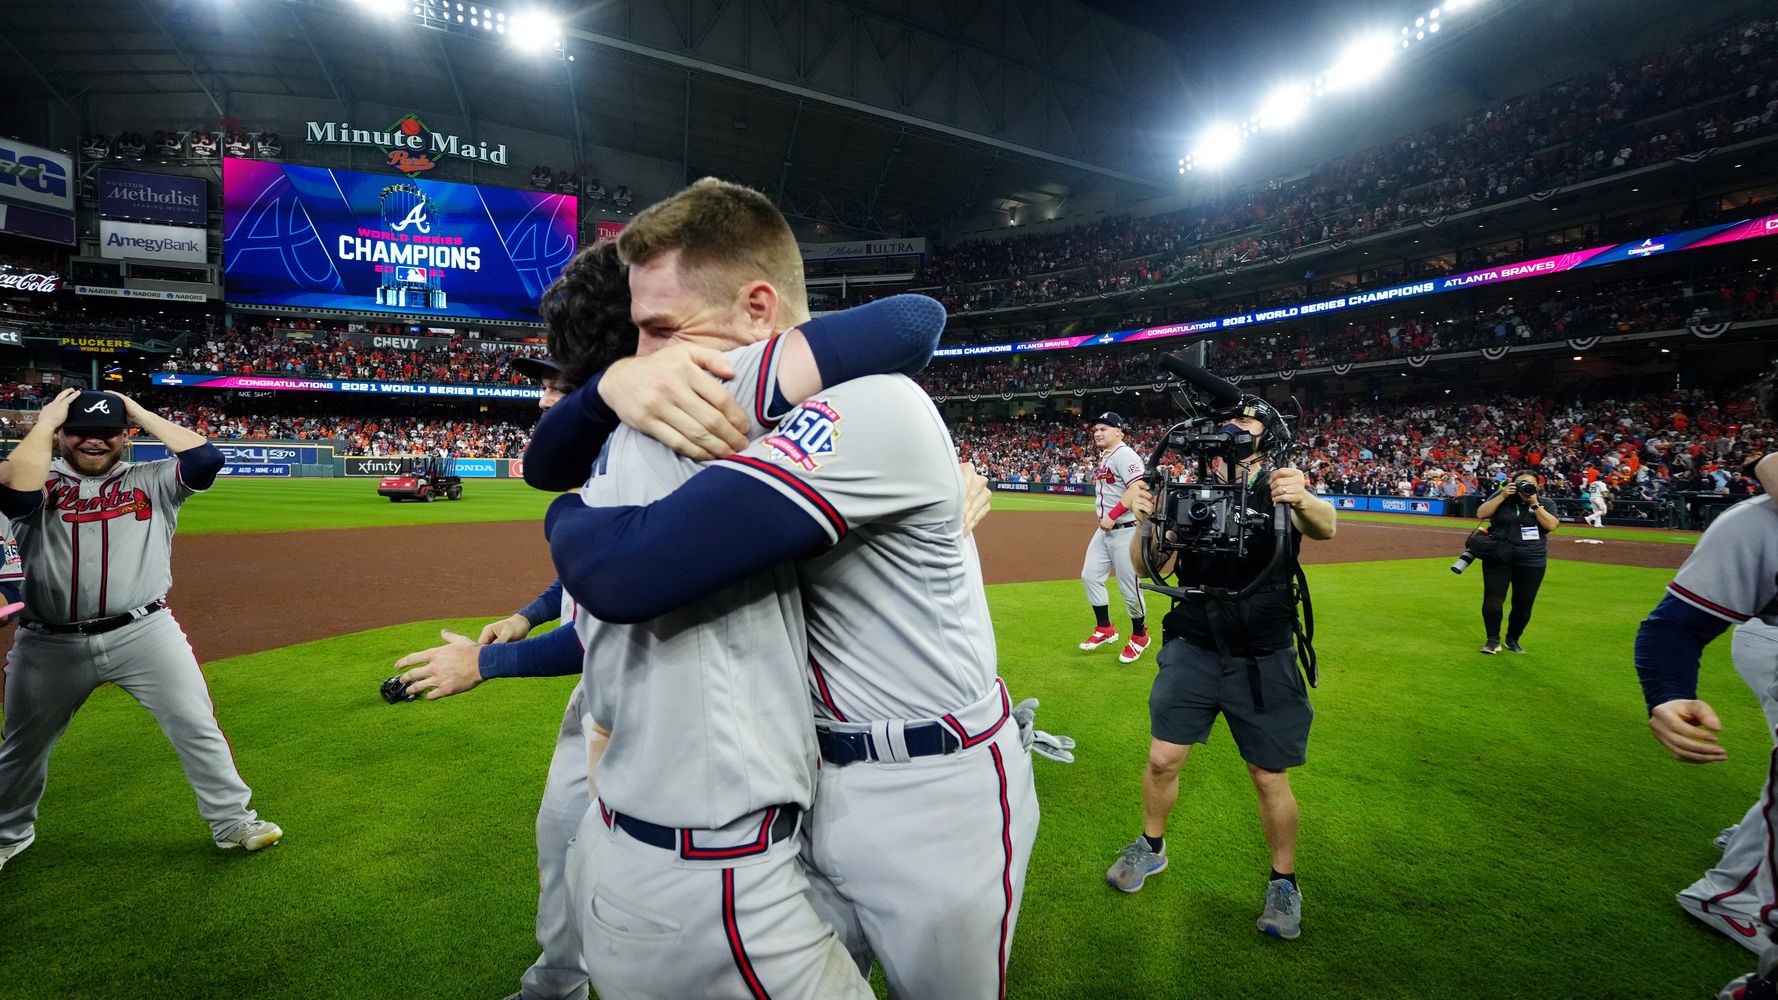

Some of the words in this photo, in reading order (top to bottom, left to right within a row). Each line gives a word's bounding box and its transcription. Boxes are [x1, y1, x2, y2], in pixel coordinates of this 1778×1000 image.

[305, 121, 423, 149] Minute
[430, 132, 508, 166] Maid
[107, 187, 200, 208] Methodist
[106, 232, 199, 253] AmegyBank
[358, 227, 409, 243] WORLD
[412, 234, 463, 245] SERIES
[338, 234, 481, 271] CHAMPIONS
[873, 242, 914, 254] ULTRA
[88, 288, 118, 296] NABORS
[132, 290, 161, 299] NABORS
[175, 293, 203, 301] NABORS
[1147, 321, 1217, 336] CONGRATULATIONS
[1222, 315, 1253, 327] 2021
[1255, 307, 1298, 322] WORLD
[1300, 299, 1346, 314] SERIES
[1348, 282, 1434, 306] CHAMPIONS
[1444, 270, 1498, 288] ATLANTA
[1501, 260, 1555, 278] BRAVES
[61, 338, 131, 348] PLUCKERS
[373, 336, 419, 349] CHEVY
[964, 345, 1012, 354] CHAMPIONS
[238, 379, 333, 390] CONGRATULATIONS
[341, 383, 377, 391] 2021
[380, 384, 426, 393] WORLD
[429, 386, 474, 395] SERIES
[358, 460, 402, 474] xfinity
